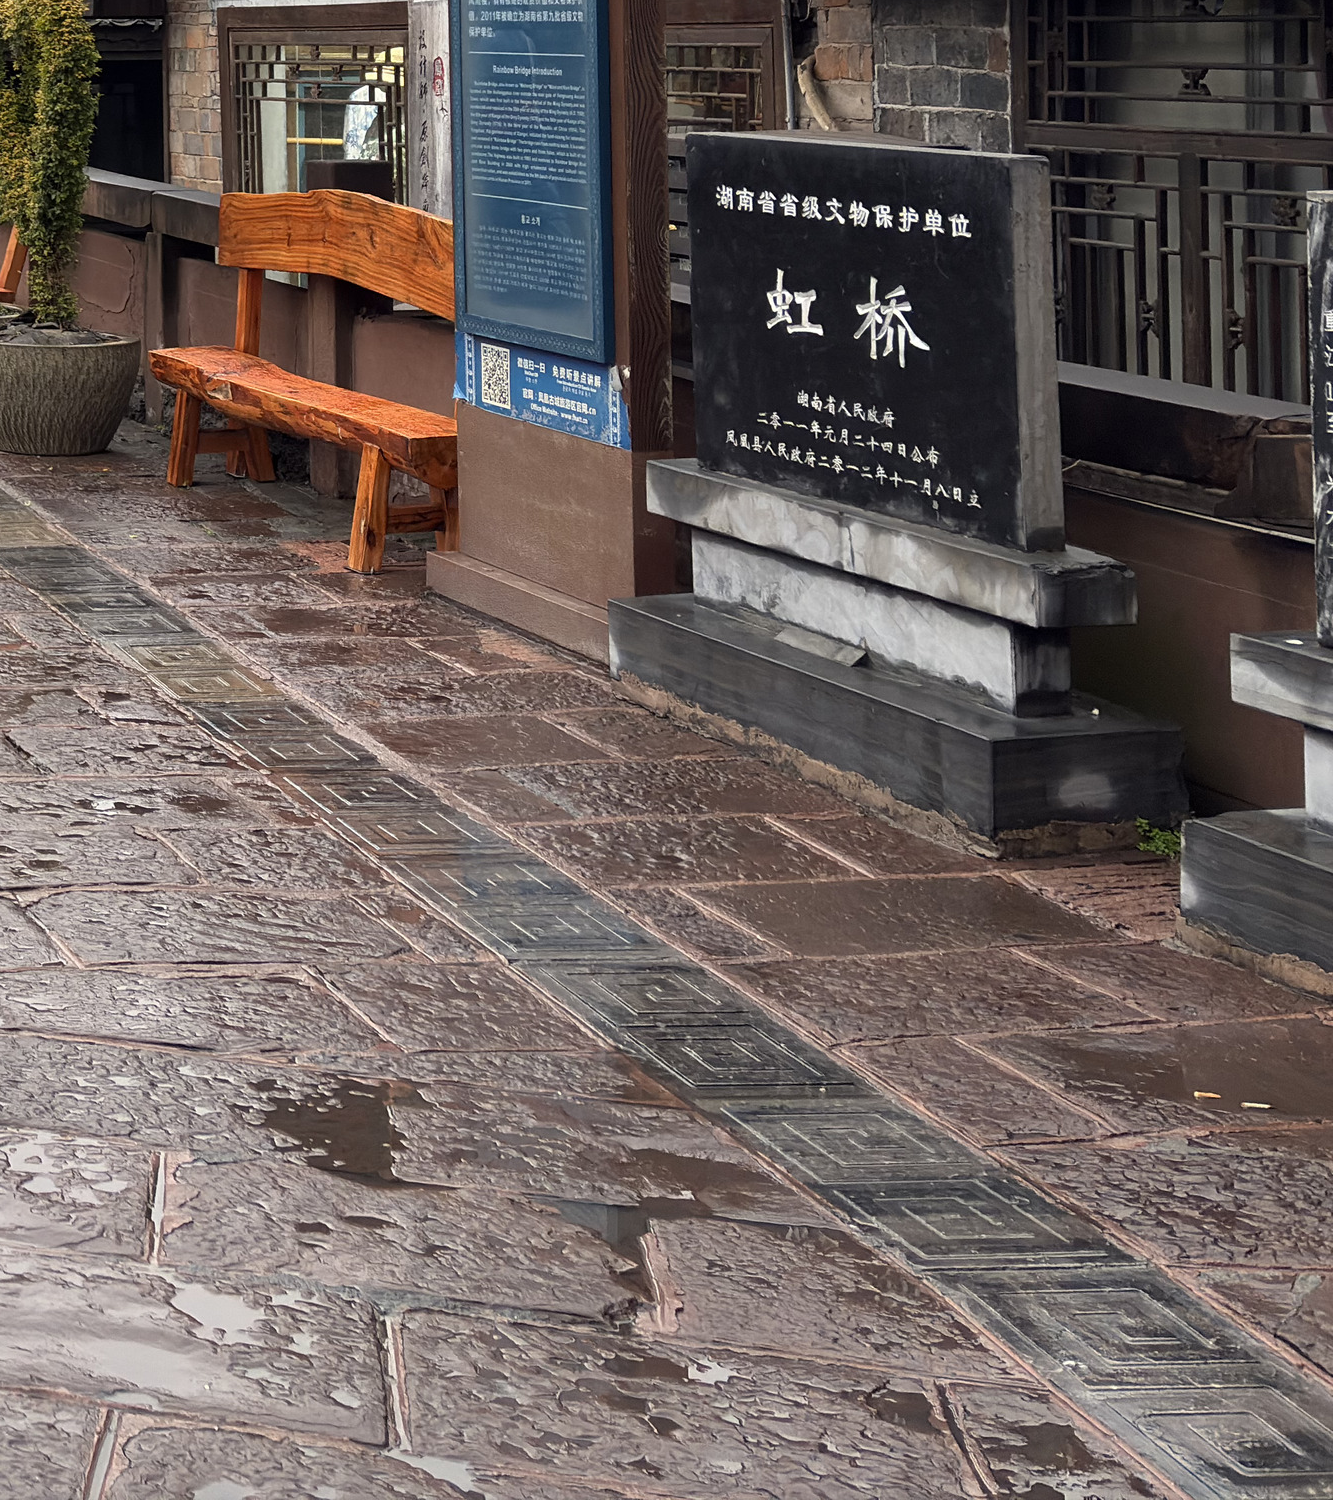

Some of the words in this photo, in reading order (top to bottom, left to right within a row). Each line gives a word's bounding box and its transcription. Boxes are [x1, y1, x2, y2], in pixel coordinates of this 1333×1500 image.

[493, 65, 514, 75] Rainbow
[514, 65, 531, 77] Bridge
[531, 66, 563, 76] Introduction
[715, 184, 973, 240] 湖南省省级文物保护单位
[765, 267, 931, 369] 虹桥
[796, 390, 896, 430] 湖南省人民政府
[756, 411, 941, 469] 二零一一年元月二十四日公布
